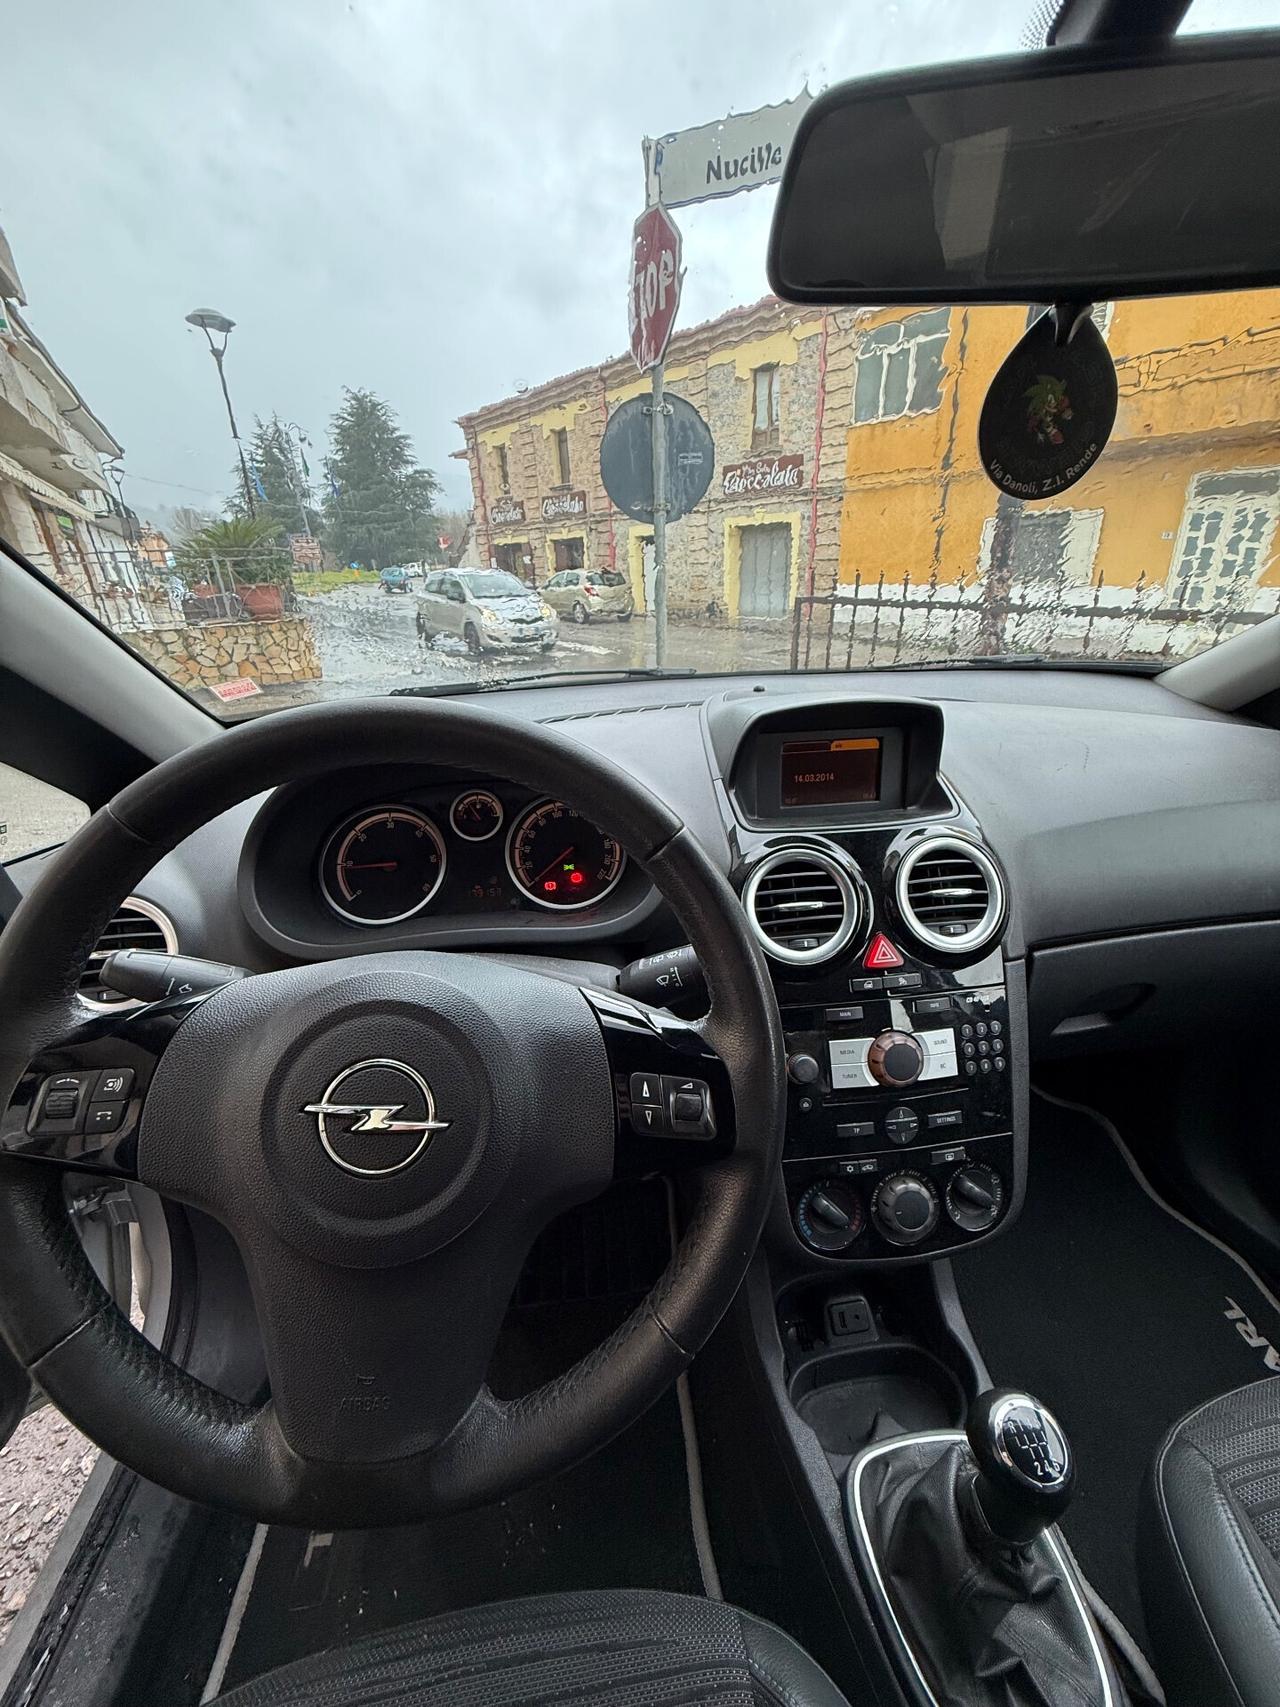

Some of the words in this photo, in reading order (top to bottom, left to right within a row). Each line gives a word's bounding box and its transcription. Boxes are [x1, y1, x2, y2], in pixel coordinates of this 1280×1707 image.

[631, 249, 675, 319] TOP
[990, 459, 1003, 479] Via
[1002, 474, 1038, 495] Danoli,
[1042, 475, 1065, 492] Z.I.
[1065, 443, 1097, 479] Rende
[794, 772, 835, 783] 14.03.2014
[936, 1116, 957, 1124] SETTINGS
[1034, 1461, 1044, 1476] 2
